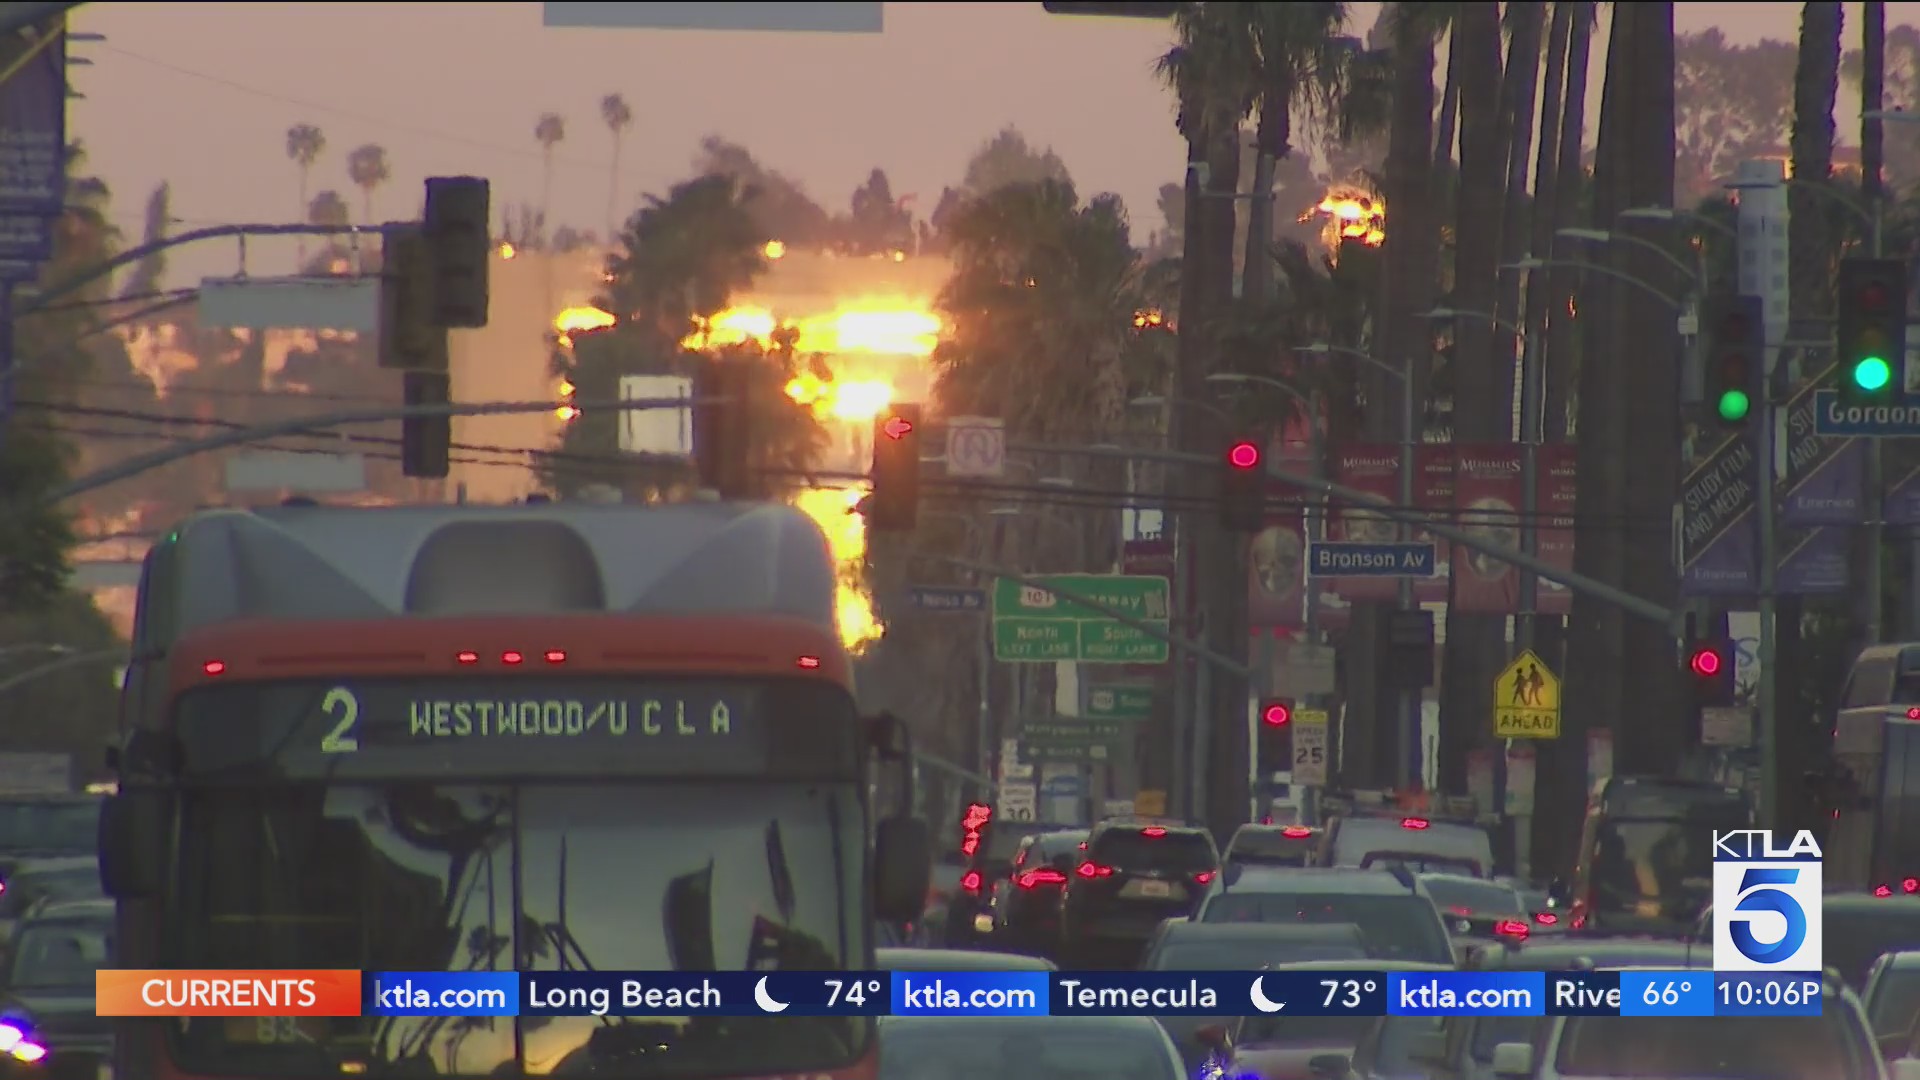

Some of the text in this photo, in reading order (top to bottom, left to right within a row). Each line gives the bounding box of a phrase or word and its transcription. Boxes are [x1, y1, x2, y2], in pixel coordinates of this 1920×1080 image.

[1685, 444, 1752, 511] STUDY FILM
[1685, 478, 1750, 543] AND MEDIA
[1319, 551, 1424, 568] Bronson Av
[321, 686, 358, 753] 2
[1500, 714, 1553, 729] AHEAD
[1296, 747, 1324, 764] 25
[1005, 806, 1032, 820] 30
